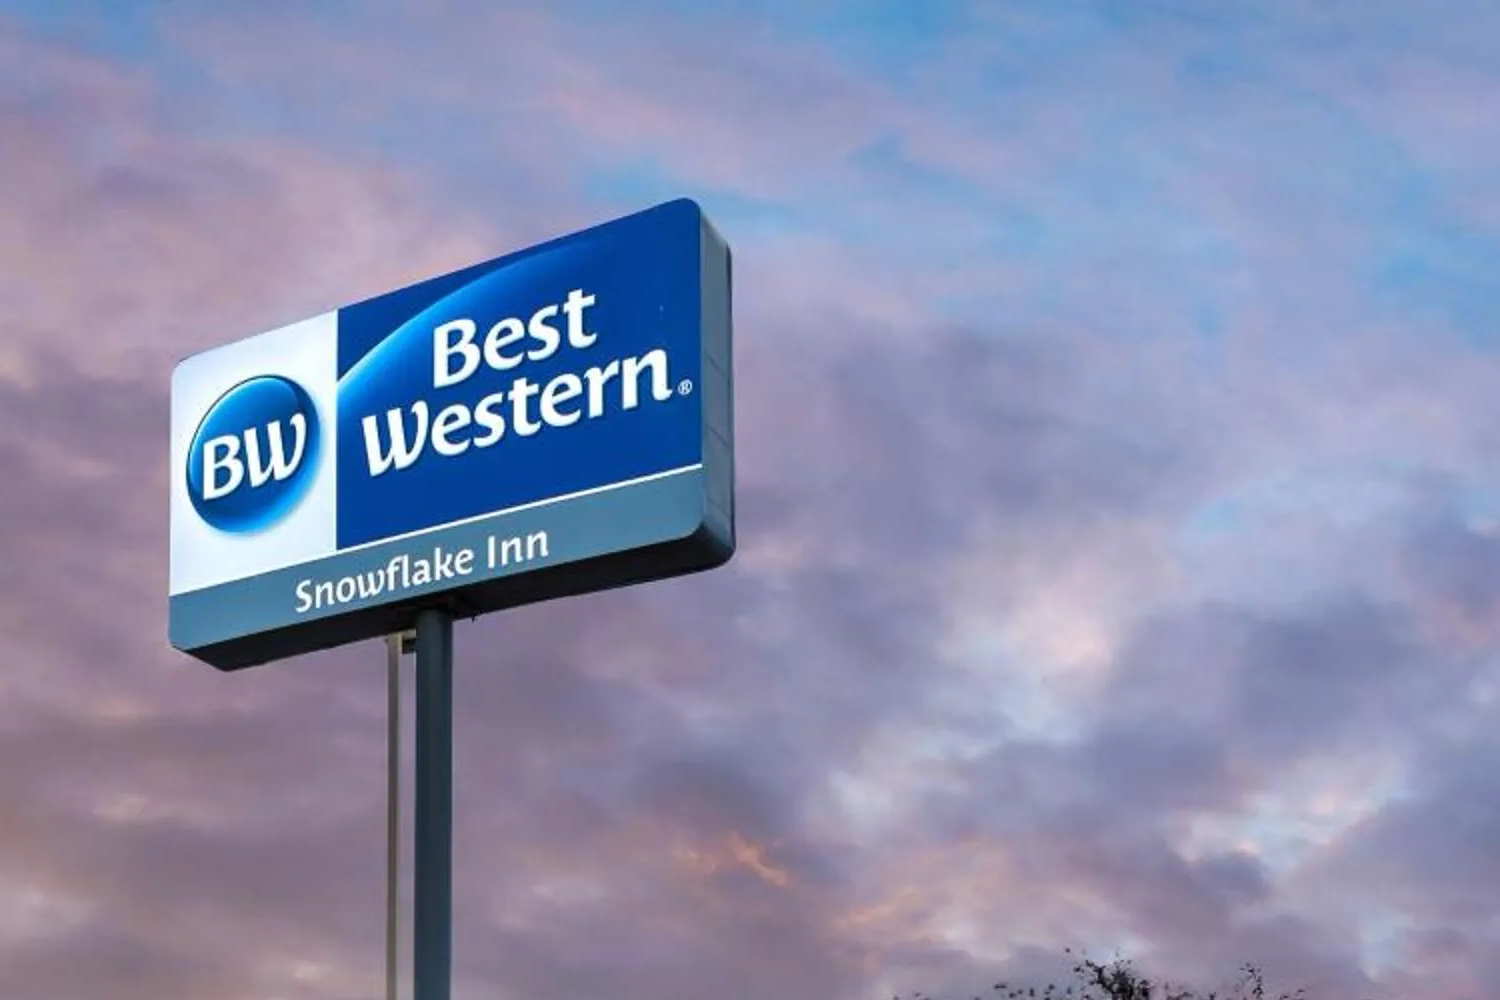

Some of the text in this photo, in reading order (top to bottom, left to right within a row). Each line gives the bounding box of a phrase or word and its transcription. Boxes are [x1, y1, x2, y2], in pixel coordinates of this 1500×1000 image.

[432, 288, 598, 389] Best
[202, 412, 307, 501] BW
[294, 529, 549, 613] Snowflake Inn
